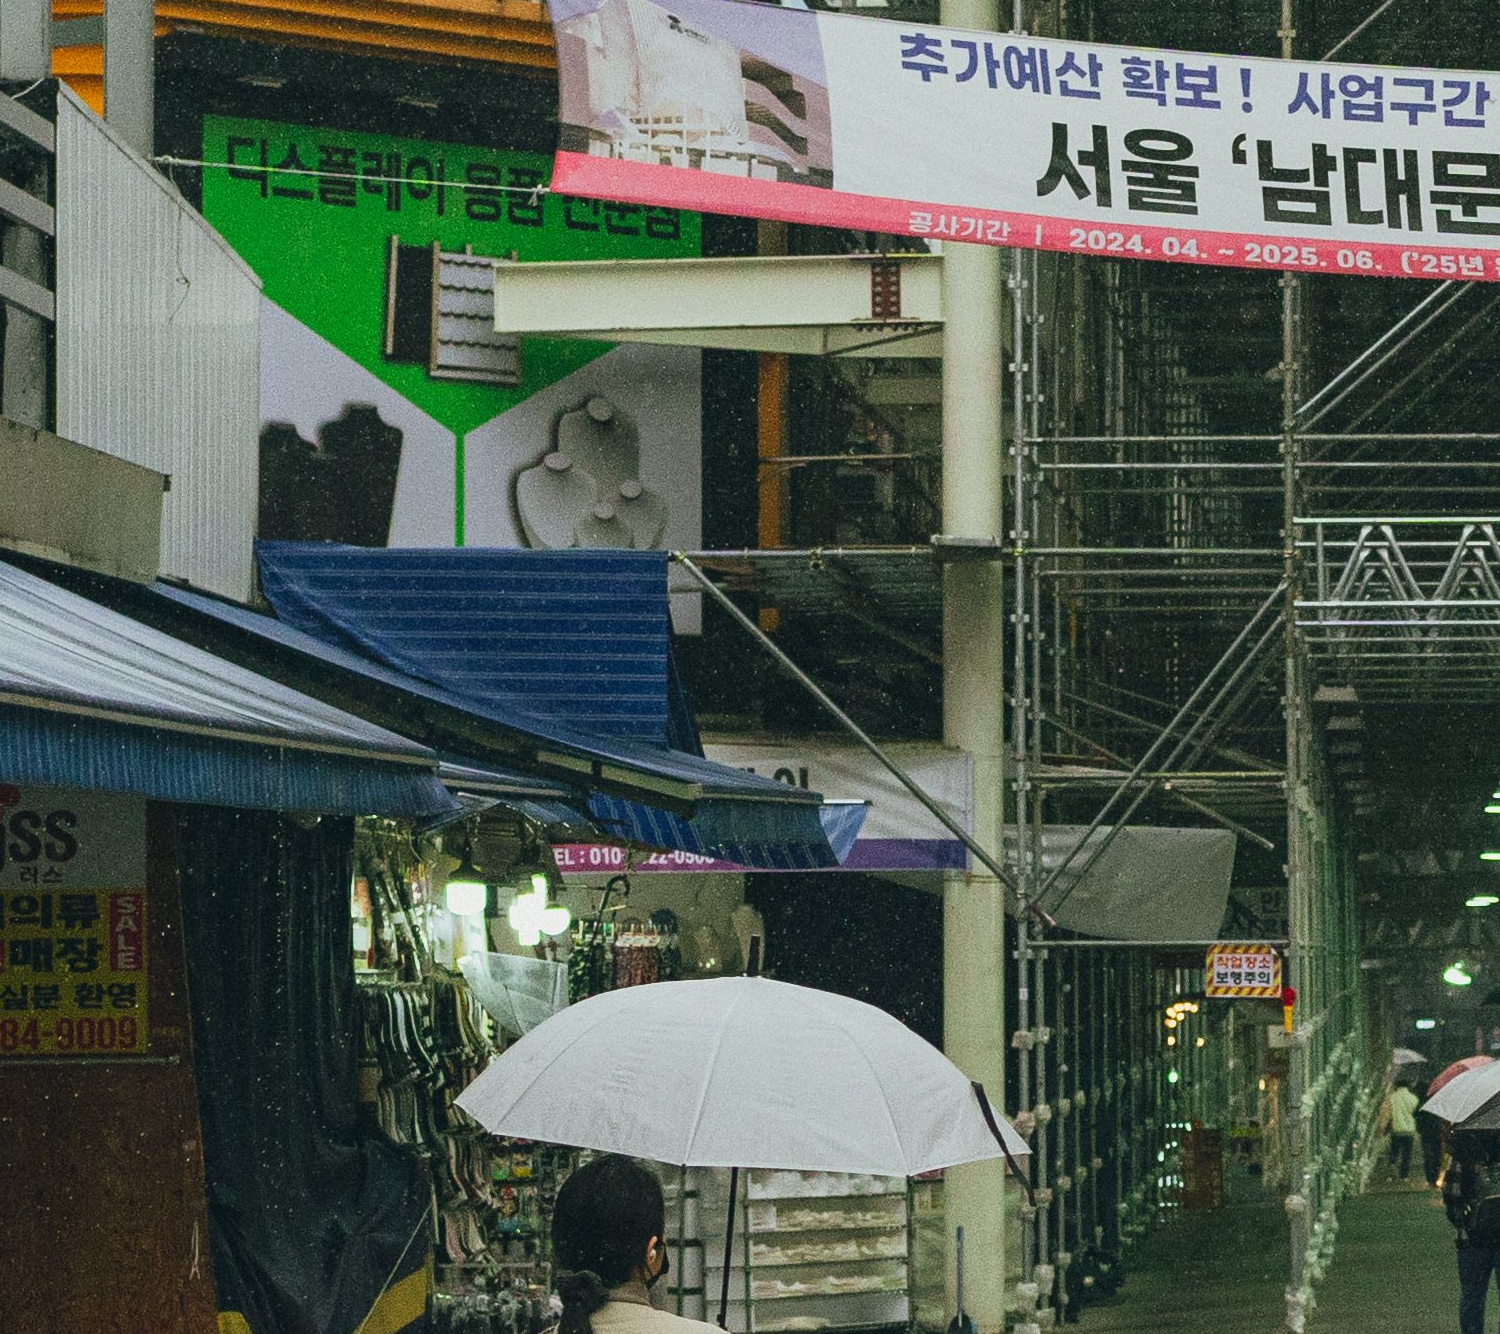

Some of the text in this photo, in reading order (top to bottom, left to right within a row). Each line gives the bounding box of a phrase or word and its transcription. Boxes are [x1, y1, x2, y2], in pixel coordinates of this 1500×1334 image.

[899, 32, 1103, 101] 추가예산
[1120, 55, 1222, 110] 확보
[1287, 71, 1491, 129] 사업구간
[226, 133, 446, 216] 디스플레이
[464, 162, 544, 227] 용품
[1036, 121, 1201, 217] 서울
[907, 210, 1013, 243] 공사기간
[1068, 228, 1152, 255] 2024.
[1163, 236, 1208, 259] 04.
[1243, 242, 1328, 268] 2025.
[1336, 249, 1383, 272] 06.
[19, 866, 63, 884] 러스
[116, 896, 137, 970] SALE
[74, 982, 137, 1009] 환영
[1216, 971, 1271, 985] 보행주의
